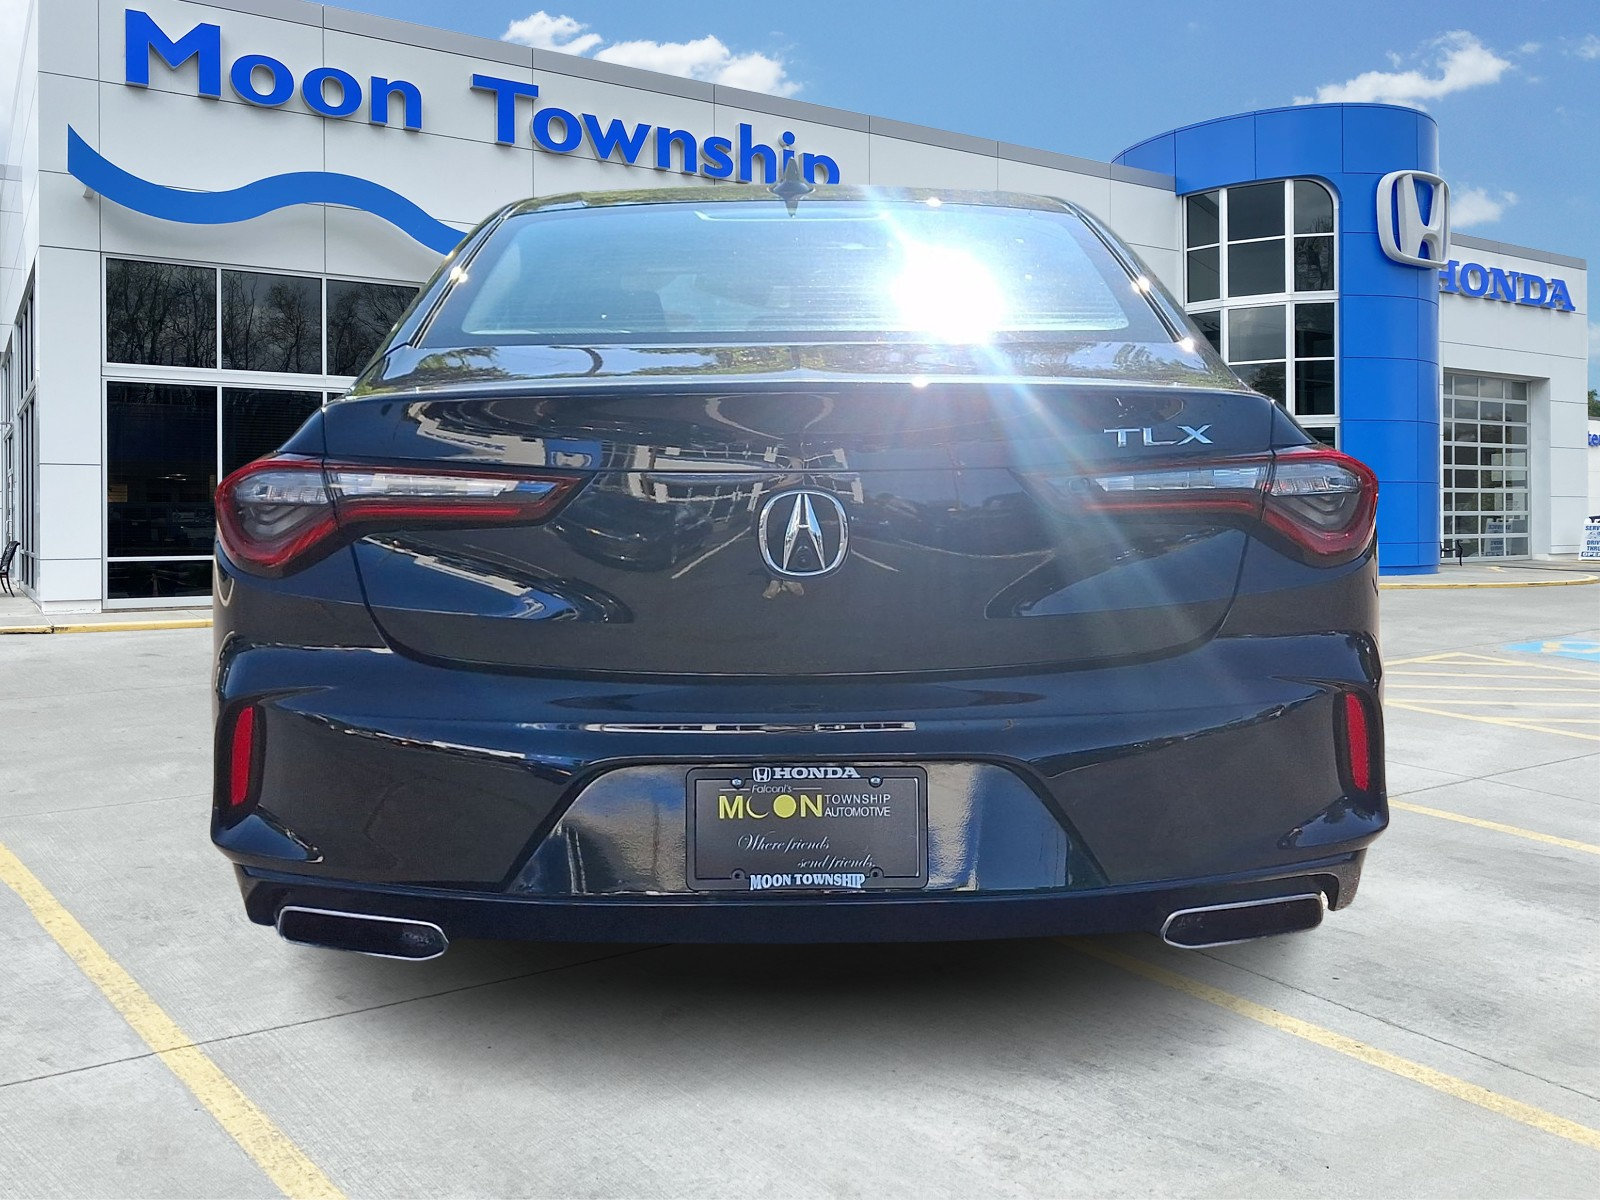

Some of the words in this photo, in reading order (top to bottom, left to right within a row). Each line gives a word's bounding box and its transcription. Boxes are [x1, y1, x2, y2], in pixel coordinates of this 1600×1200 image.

[124, 8, 423, 132] Moon
[469, 73, 841, 185] Township
[1103, 424, 1214, 448] TLX
[773, 766, 861, 779] HONDA
[824, 794, 891, 805] TOWNSHIP
[824, 806, 891, 818] AUTOMOTIVE
[737, 831, 785, 851] Where
[784, 836, 830, 853] friends
[797, 854, 831, 869] send
[749, 874, 792, 891] MOON
[793, 873, 866, 889] TOWNSHIP
